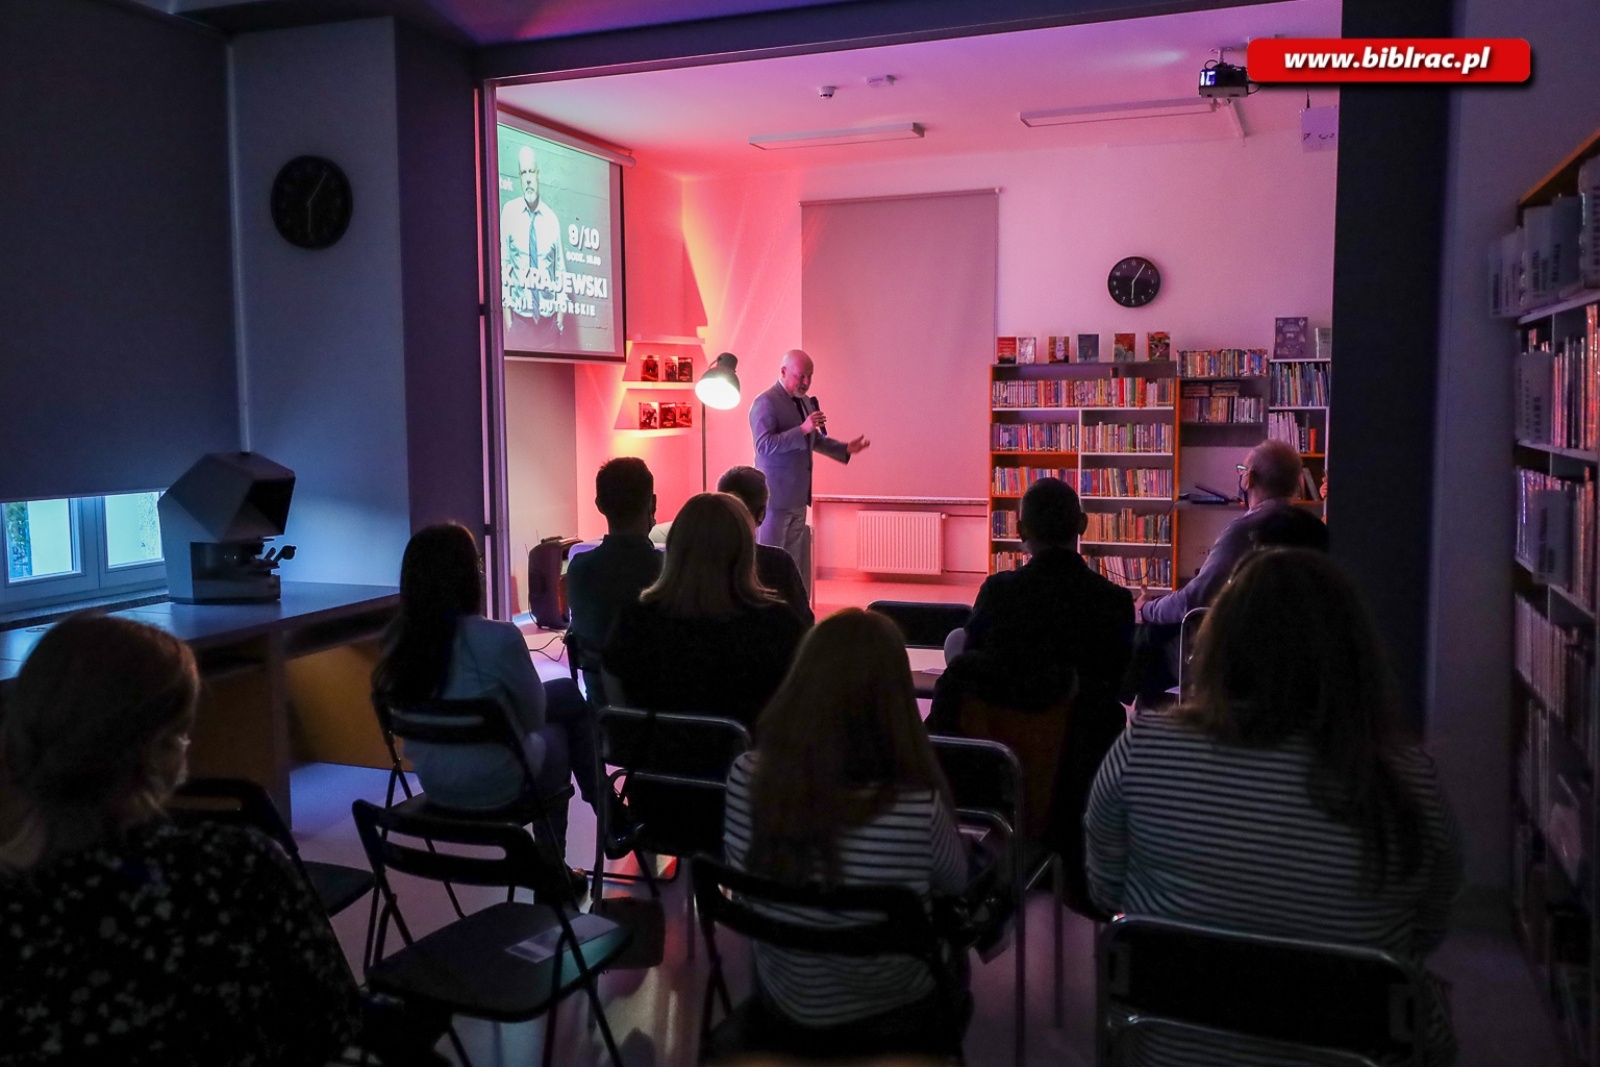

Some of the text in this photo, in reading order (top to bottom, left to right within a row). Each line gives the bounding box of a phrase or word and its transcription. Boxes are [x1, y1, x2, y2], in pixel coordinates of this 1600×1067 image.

[568, 223, 600, 250] 9/10
[518, 267, 608, 299] KRAJEWSKI
[540, 299, 596, 316] AUTORSKIE
